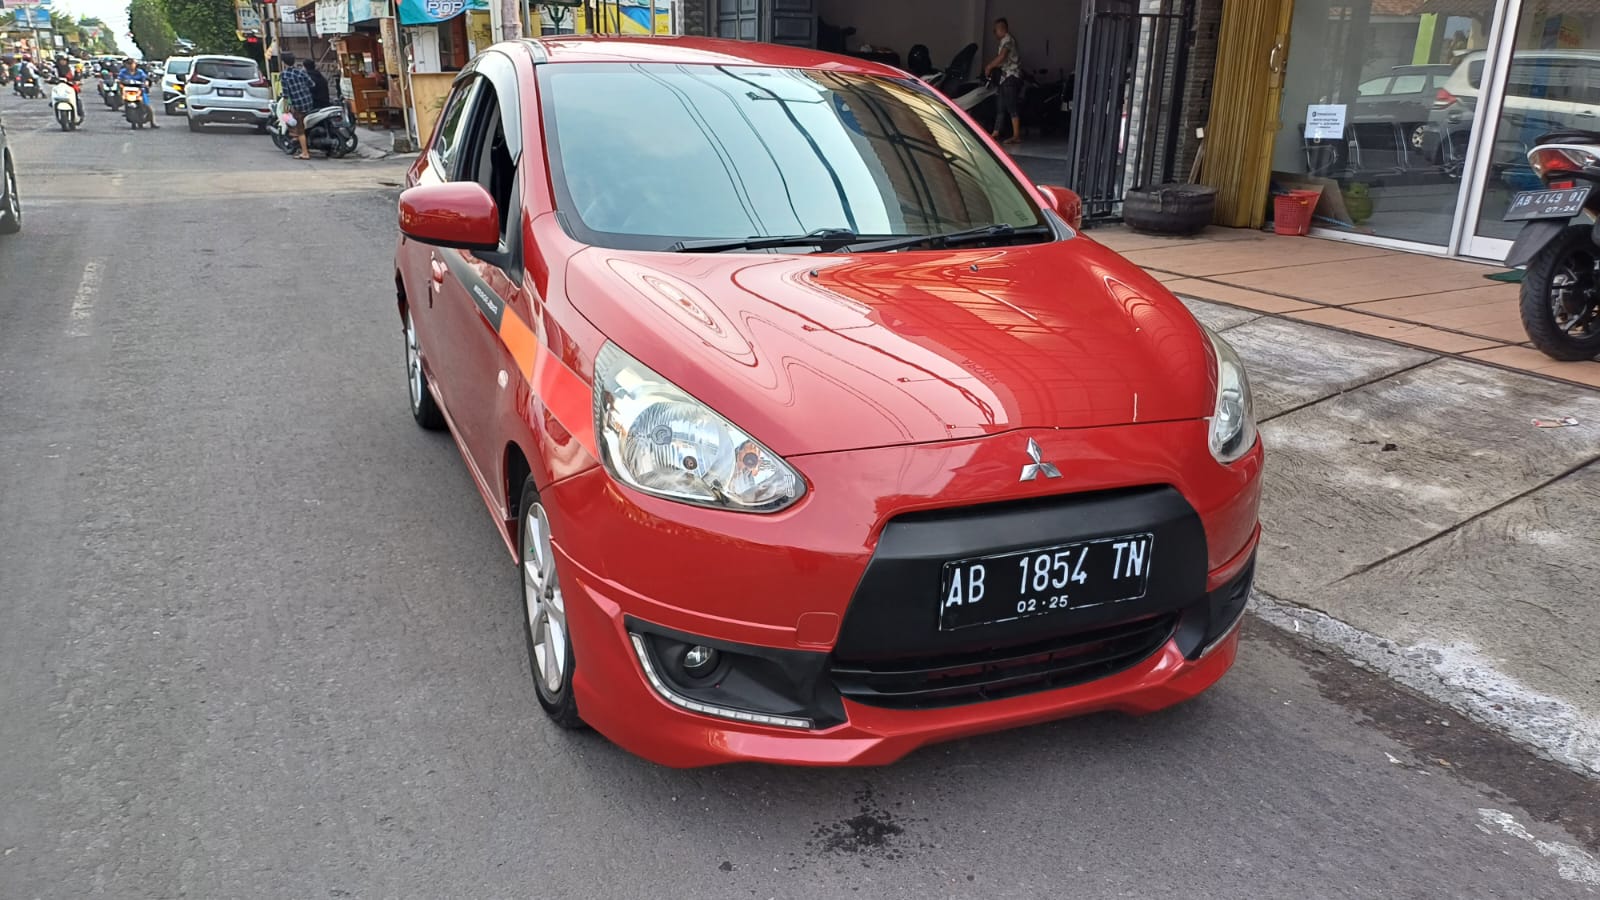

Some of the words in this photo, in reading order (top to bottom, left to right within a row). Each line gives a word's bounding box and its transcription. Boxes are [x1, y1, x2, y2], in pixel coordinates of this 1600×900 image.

[1516, 195, 1532, 207] AB
[945, 564, 986, 607] AB
[1019, 547, 1089, 594] 1854
[1112, 540, 1146, 580] TN
